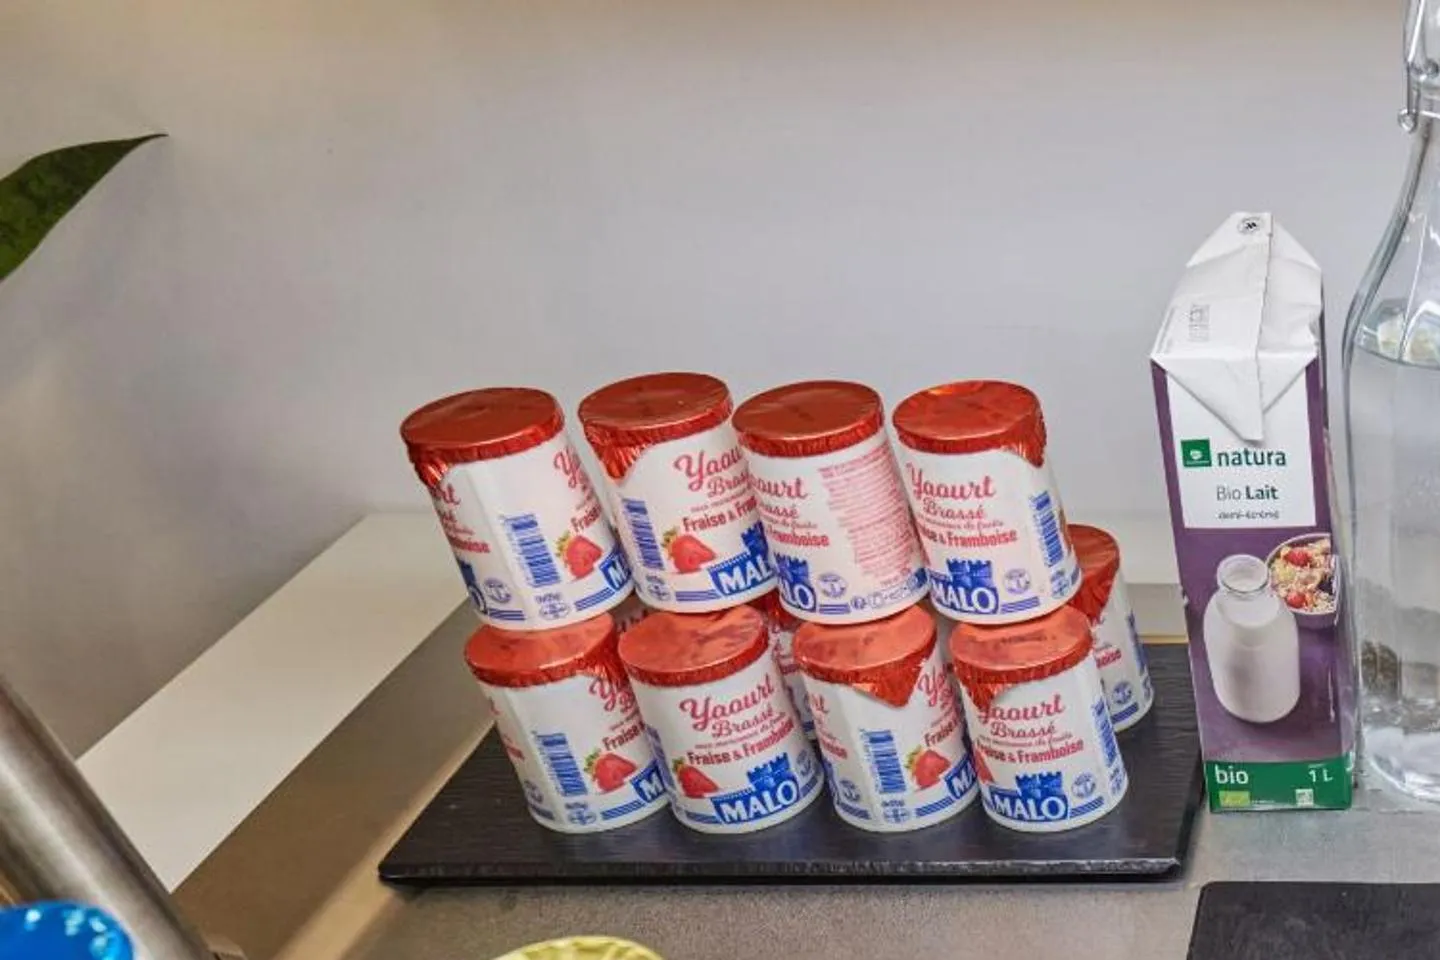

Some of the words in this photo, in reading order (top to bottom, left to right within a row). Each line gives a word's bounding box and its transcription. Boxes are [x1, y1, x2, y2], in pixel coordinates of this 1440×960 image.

[673, 447, 742, 492] Yaou
[1217, 447, 1288, 468] natura
[905, 462, 996, 500] Yaourt
[1217, 485, 1242, 502] Bio
[1245, 484, 1280, 501] Lait
[922, 497, 987, 520] Brassé
[682, 512, 727, 532] Fraise
[946, 527, 1019, 548] Framboise
[718, 555, 774, 594] MAL
[931, 578, 996, 613] MALO
[678, 672, 775, 732] Yaourt
[711, 702, 774, 738] Brassé
[990, 720, 1056, 738] Brassé
[687, 750, 732, 766] Fraise
[1017, 739, 1085, 764] Framboise
[1214, 763, 1249, 785] bio
[1322, 768, 1334, 783] L
[721, 780, 798, 823] MALO
[993, 795, 1067, 821] MALO
